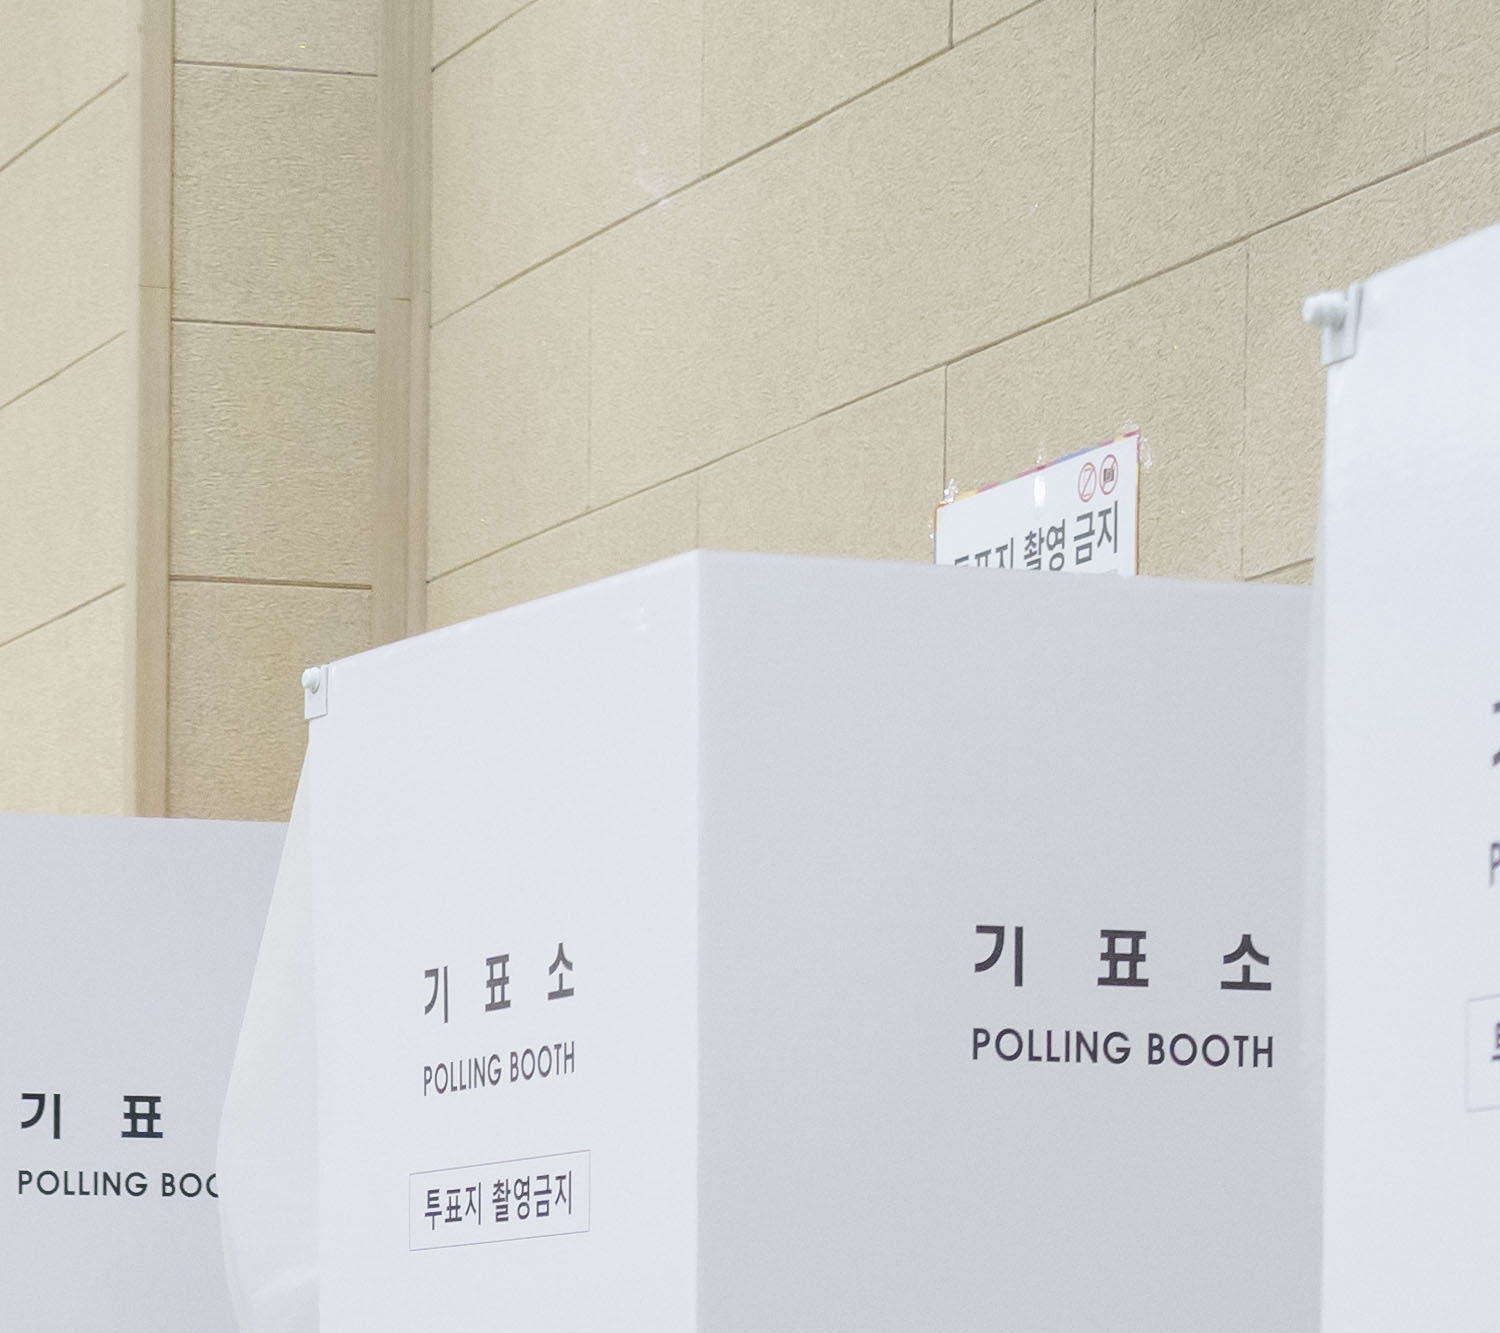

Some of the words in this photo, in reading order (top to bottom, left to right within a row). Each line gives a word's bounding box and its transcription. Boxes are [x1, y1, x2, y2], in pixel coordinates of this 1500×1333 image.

[1023, 519, 1066, 571] 촬영
[1073, 501, 1118, 565] 금지
[423, 1053, 502, 1096] POLLING
[510, 1041, 575, 1082] BOOTH
[973, 1028, 1131, 1064] POLLING
[1148, 1033, 1273, 1068] BOOTH
[21, 1093, 163, 1139] 기표
[18, 1170, 147, 1197] POLLING
[162, 1173, 219, 1198] BOO
[424, 1181, 482, 1230] 투표지
[492, 1170, 572, 1223] 촬영금지
